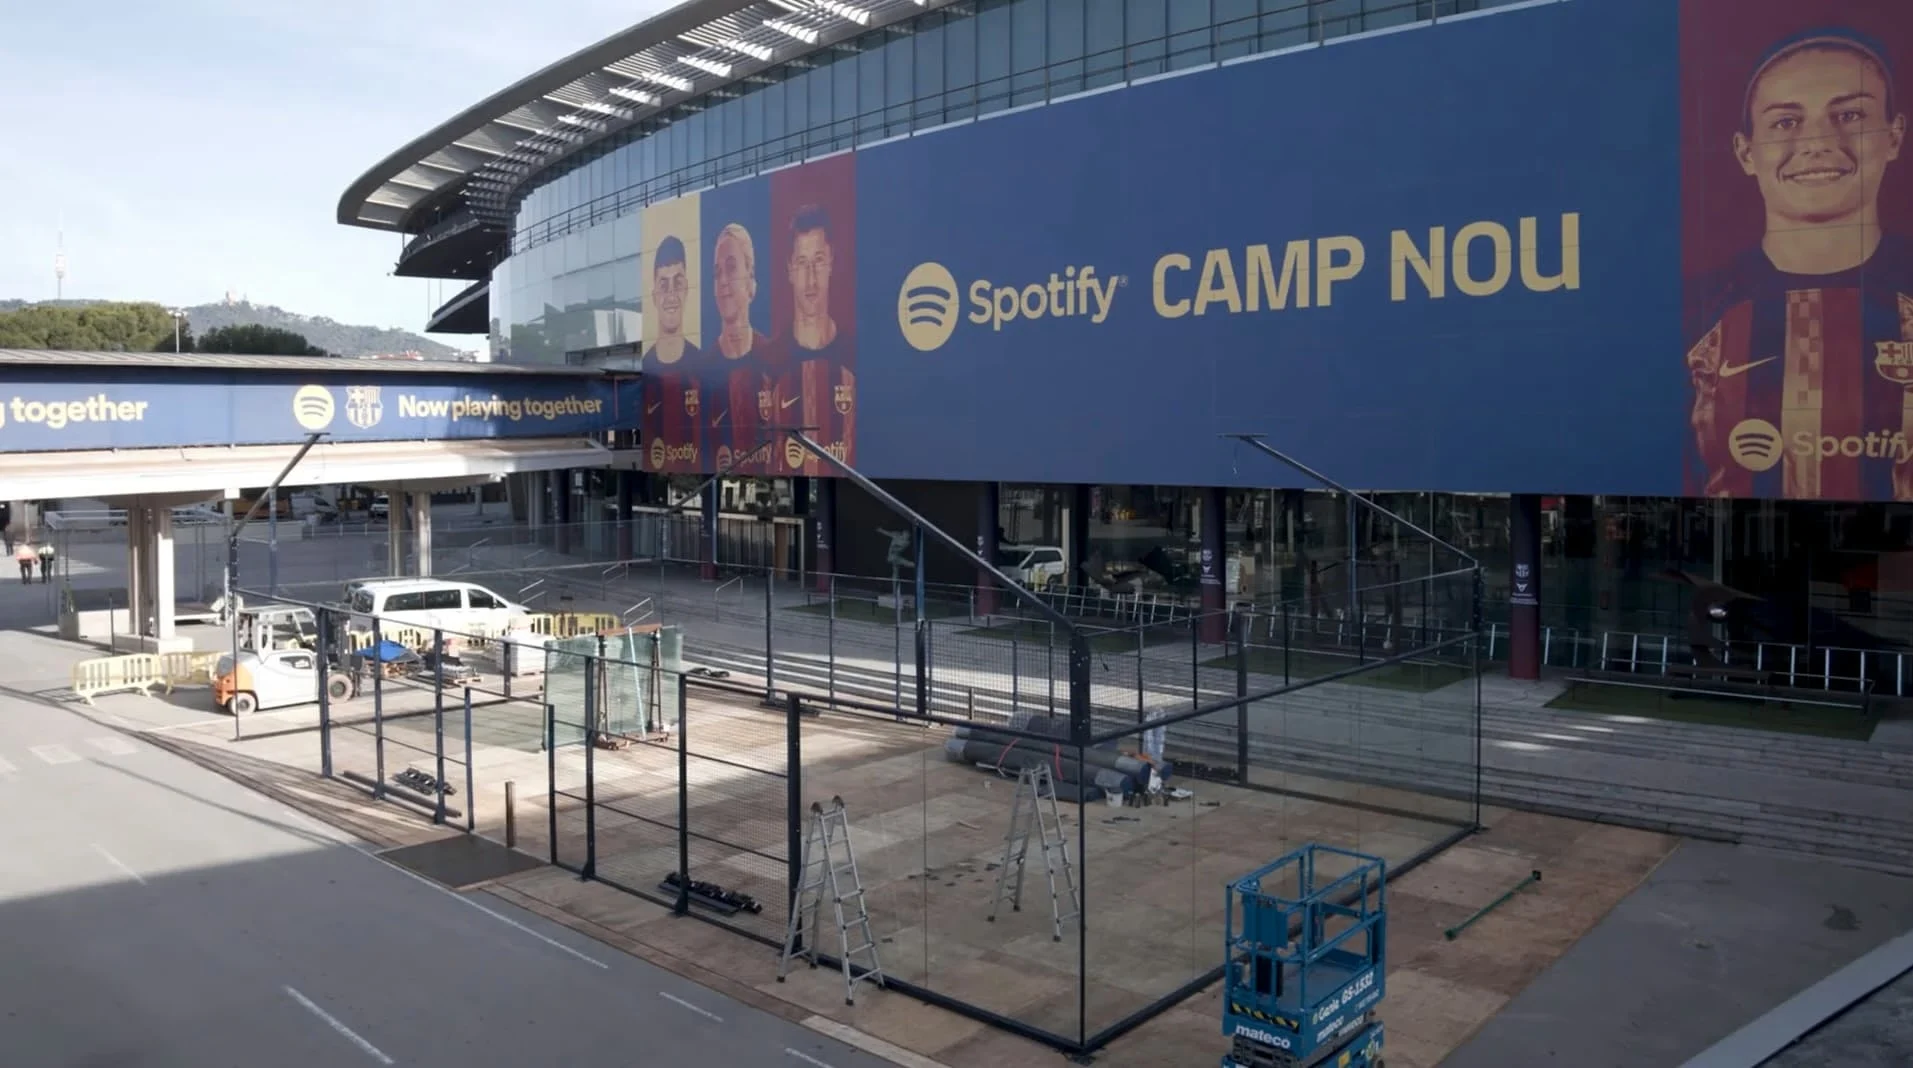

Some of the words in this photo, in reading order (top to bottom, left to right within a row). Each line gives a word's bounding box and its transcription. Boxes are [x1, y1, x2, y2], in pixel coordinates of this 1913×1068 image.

[967, 265, 1119, 331] Spotify
[1152, 236, 1366, 319] CAMP
[1390, 212, 1581, 302] NOU
[10, 393, 148, 429] together
[398, 394, 449, 418] Now
[452, 394, 522, 421] playing
[523, 395, 603, 420] together
[666, 442, 698, 463] Spotify
[1235, 1024, 1291, 1049] mateco
